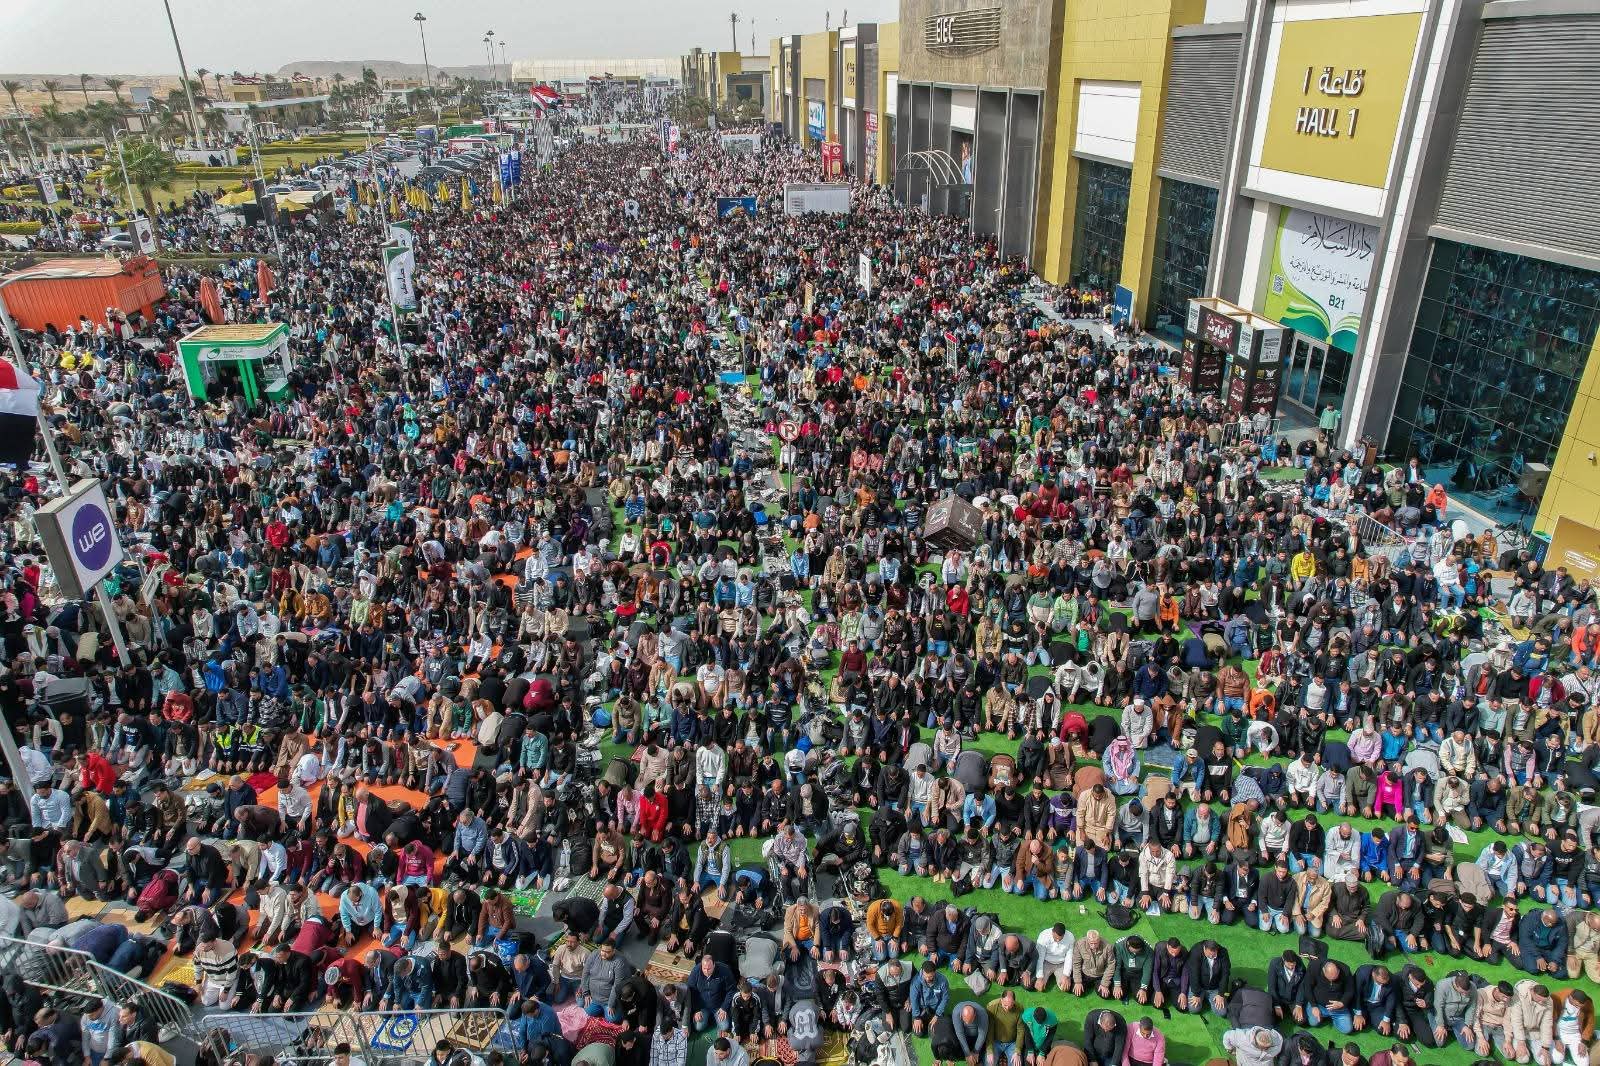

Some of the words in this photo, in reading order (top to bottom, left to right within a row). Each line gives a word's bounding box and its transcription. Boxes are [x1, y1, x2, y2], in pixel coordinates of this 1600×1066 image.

[936, 17, 954, 43] EIEC
[1319, 67, 1365, 97] قاعة
[1295, 107, 1340, 137] HALL
[1348, 109, 1359, 139] 1
[1328, 294, 1345, 311] B21
